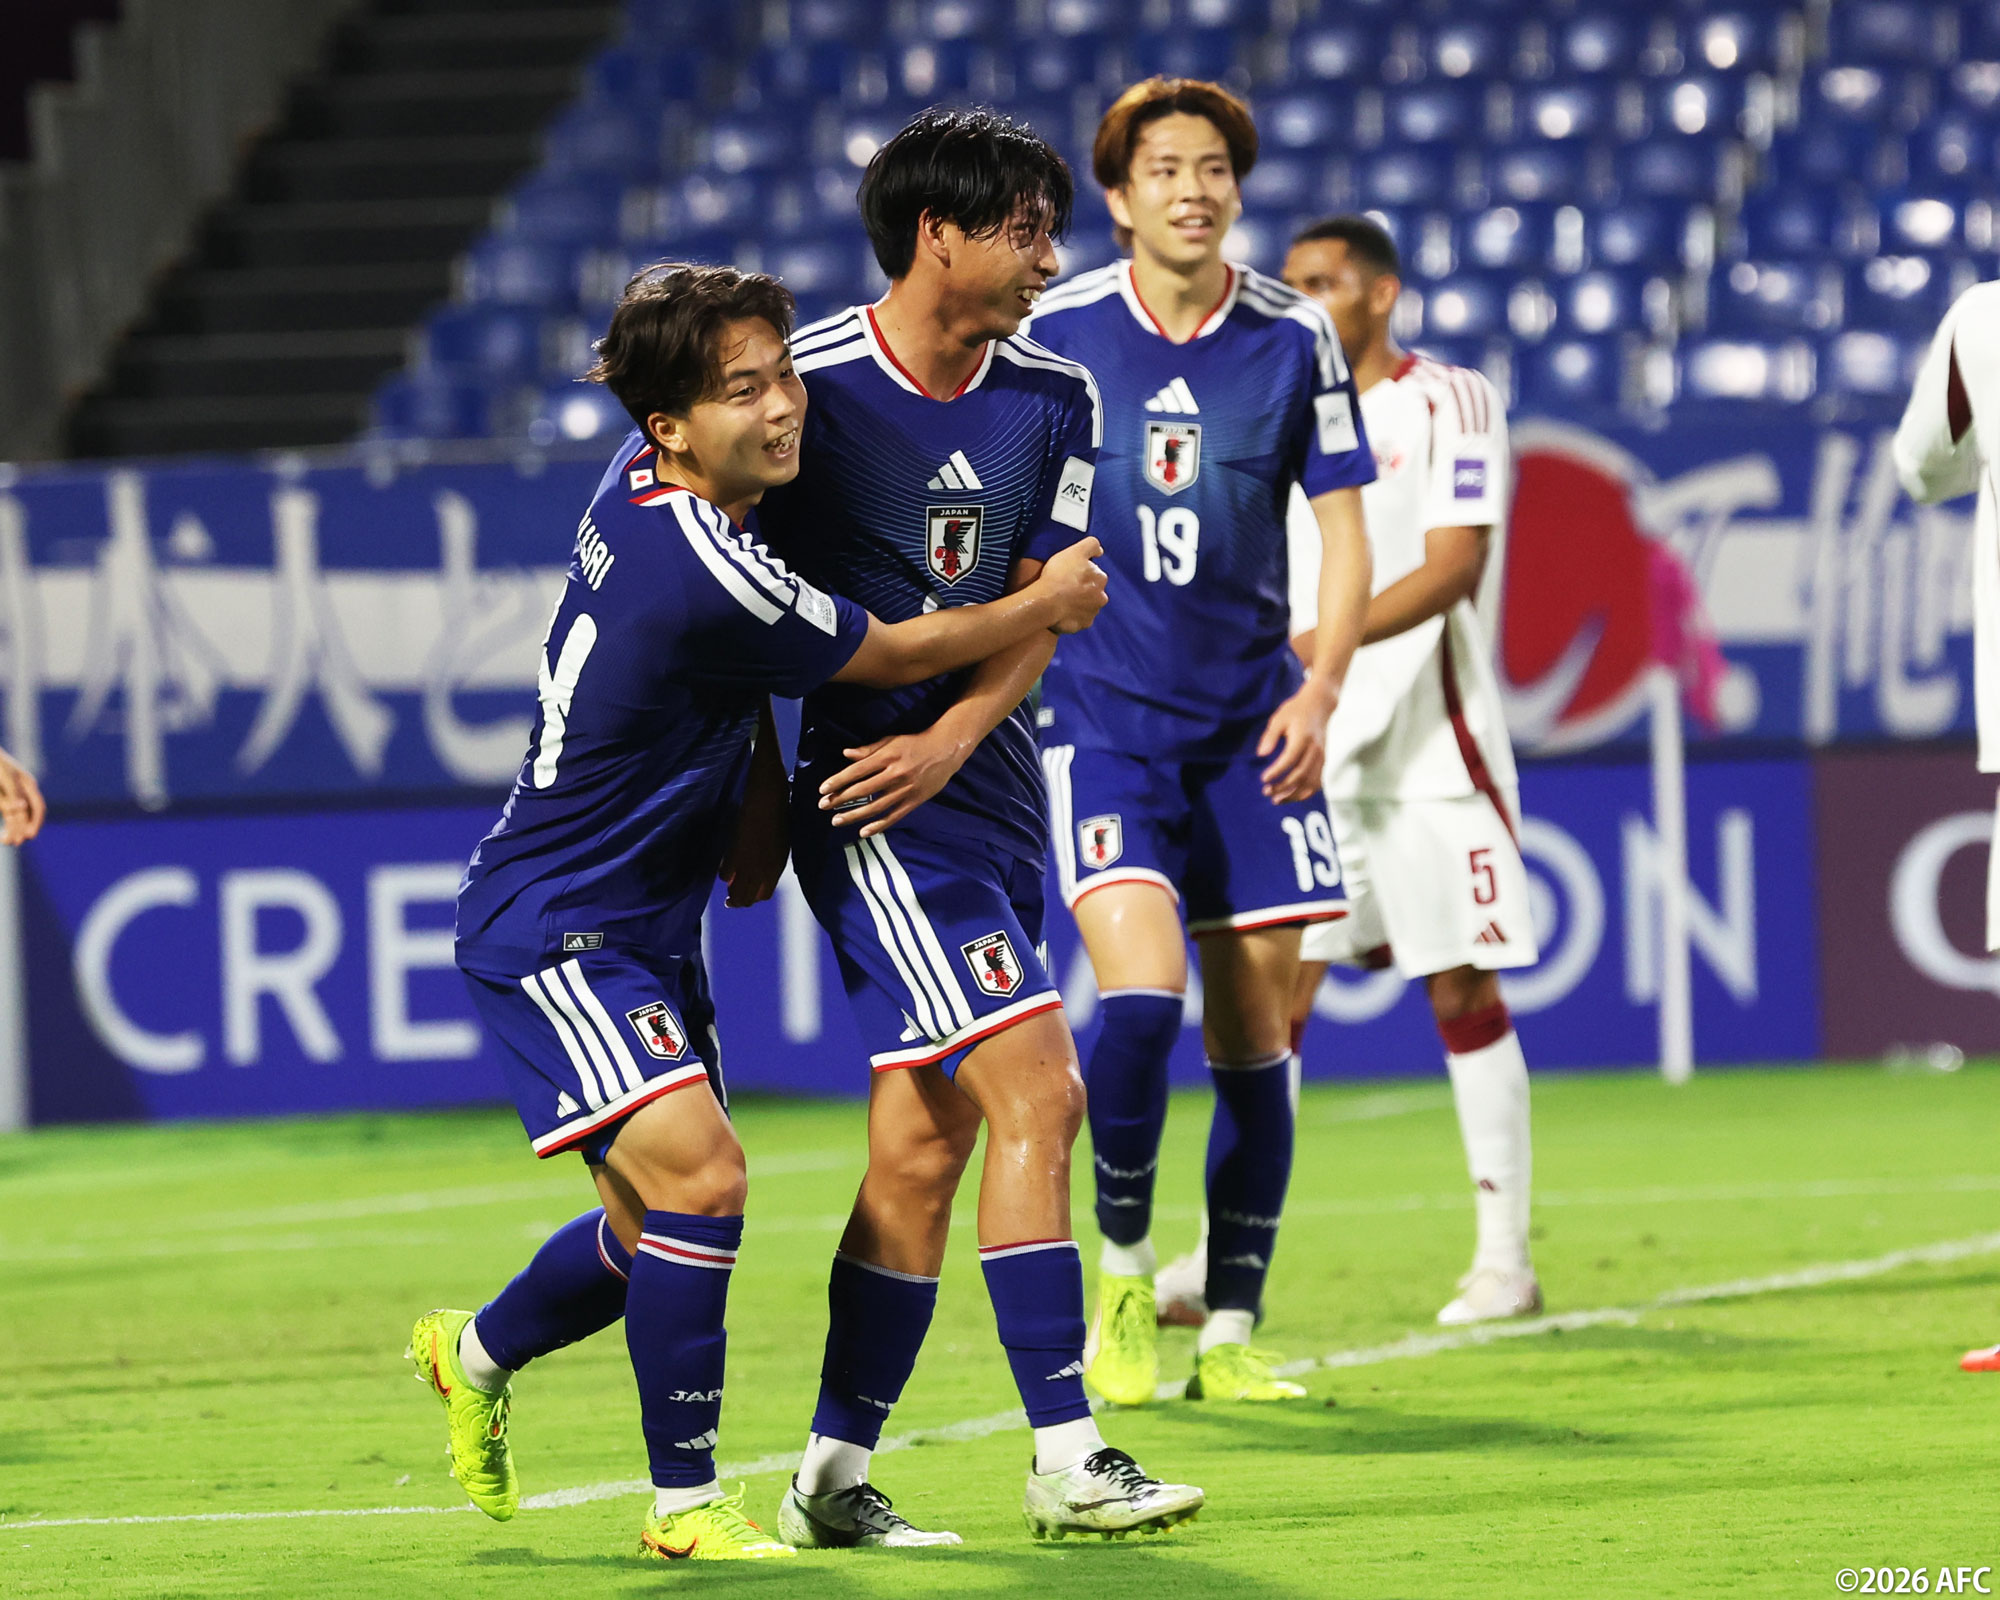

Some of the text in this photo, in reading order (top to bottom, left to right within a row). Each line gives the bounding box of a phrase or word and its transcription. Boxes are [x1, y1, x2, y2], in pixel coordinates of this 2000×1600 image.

[1062, 482, 1087, 502] AFC
[1136, 504, 1200, 586] 19
[1281, 810, 1342, 893] 19
[1469, 848, 1496, 904] 5
[974, 936, 998, 950] JAPAN
[638, 1005, 658, 1017] JAPAN
